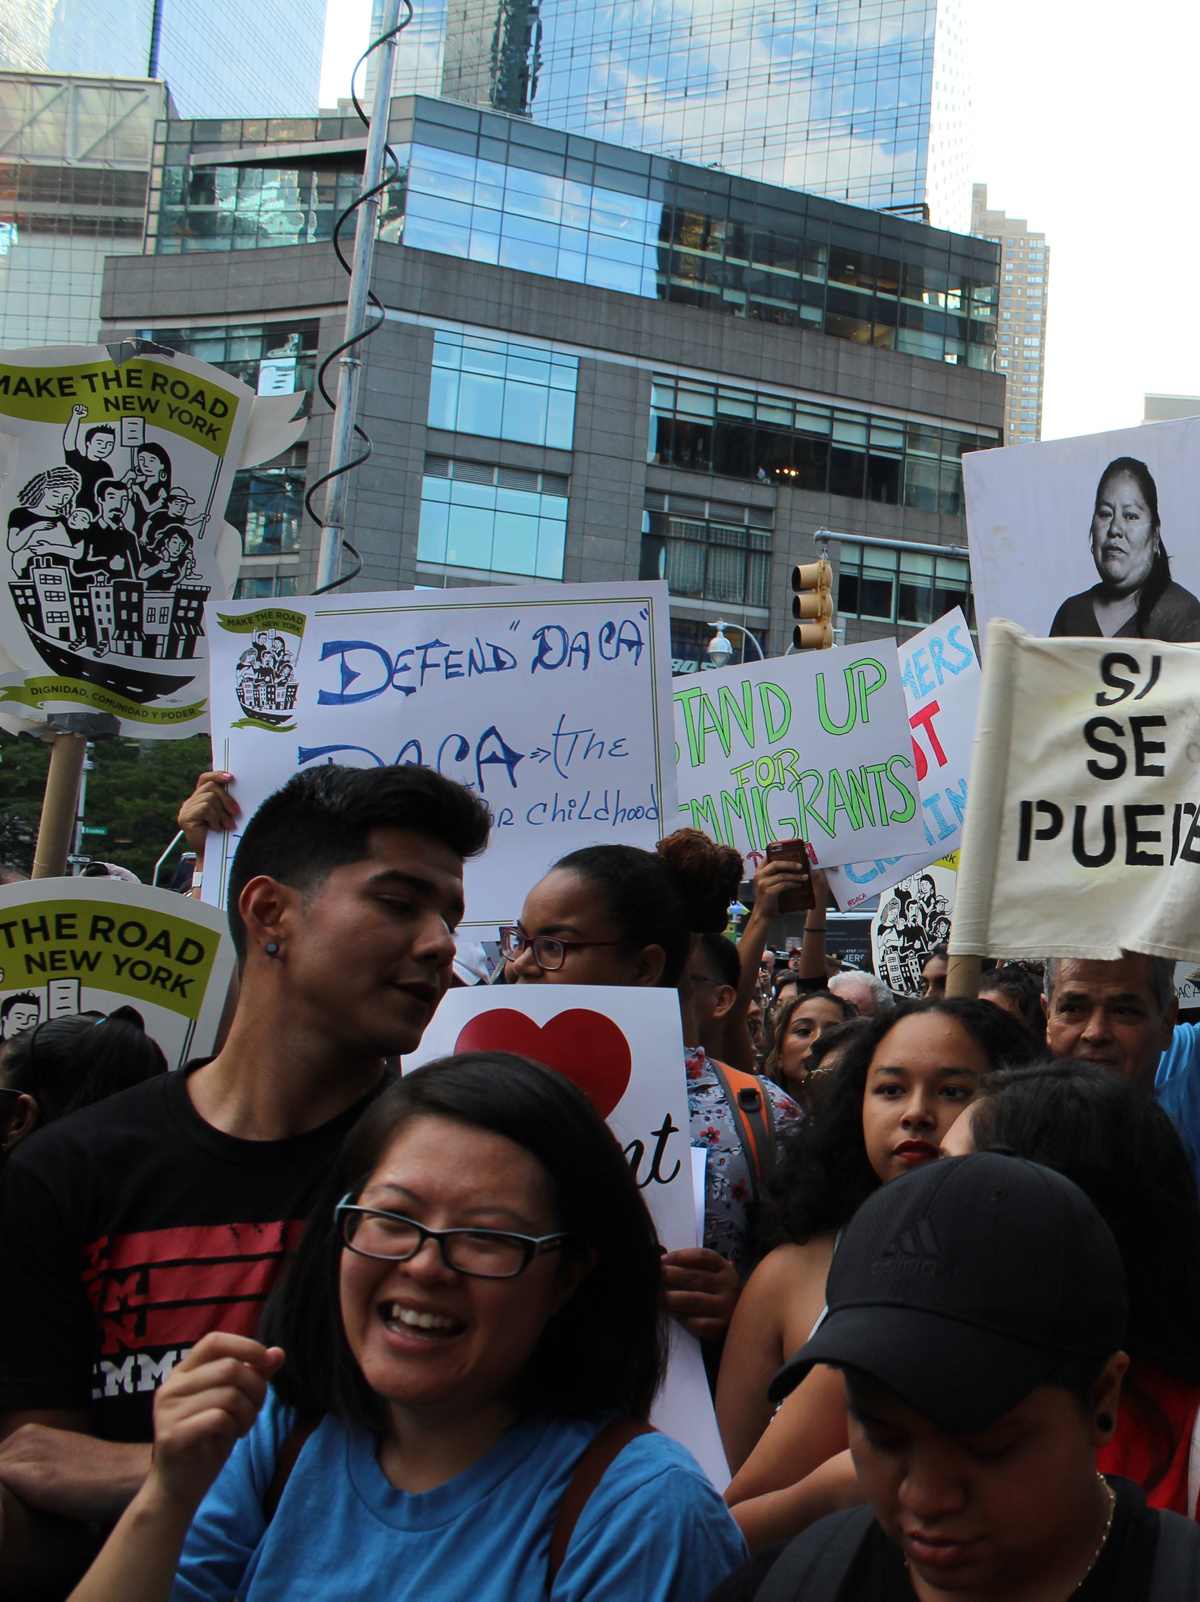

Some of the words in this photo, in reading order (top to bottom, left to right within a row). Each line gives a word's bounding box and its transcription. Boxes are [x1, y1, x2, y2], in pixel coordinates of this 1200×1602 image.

[81, 368, 143, 393] THE
[151, 372, 229, 419] ROAD
[103, 394, 158, 414] NEW
[167, 402, 224, 442] YORK
[227, 616, 254, 627] MAKE
[255, 611, 274, 621] THE
[275, 611, 304, 625] ROAD
[262, 620, 279, 628] NEW
[282, 621, 302, 632] YORK
[317, 636, 518, 706] DEFEND
[30, 685, 89, 699] DIGNIDAD,
[91, 692, 149, 719] COMUNIDAD
[152, 711, 159, 719] Y
[161, 708, 196, 720] PODER
[673, 680, 792, 768] TAND
[815, 657, 887, 736] UP
[730, 748, 801, 788] FOR
[1083, 715, 1167, 781] SE
[0, 913, 78, 949] THE
[88, 914, 205, 966] ROAD
[24, 949, 103, 975] NEW
[112, 953, 196, 999] YORK
